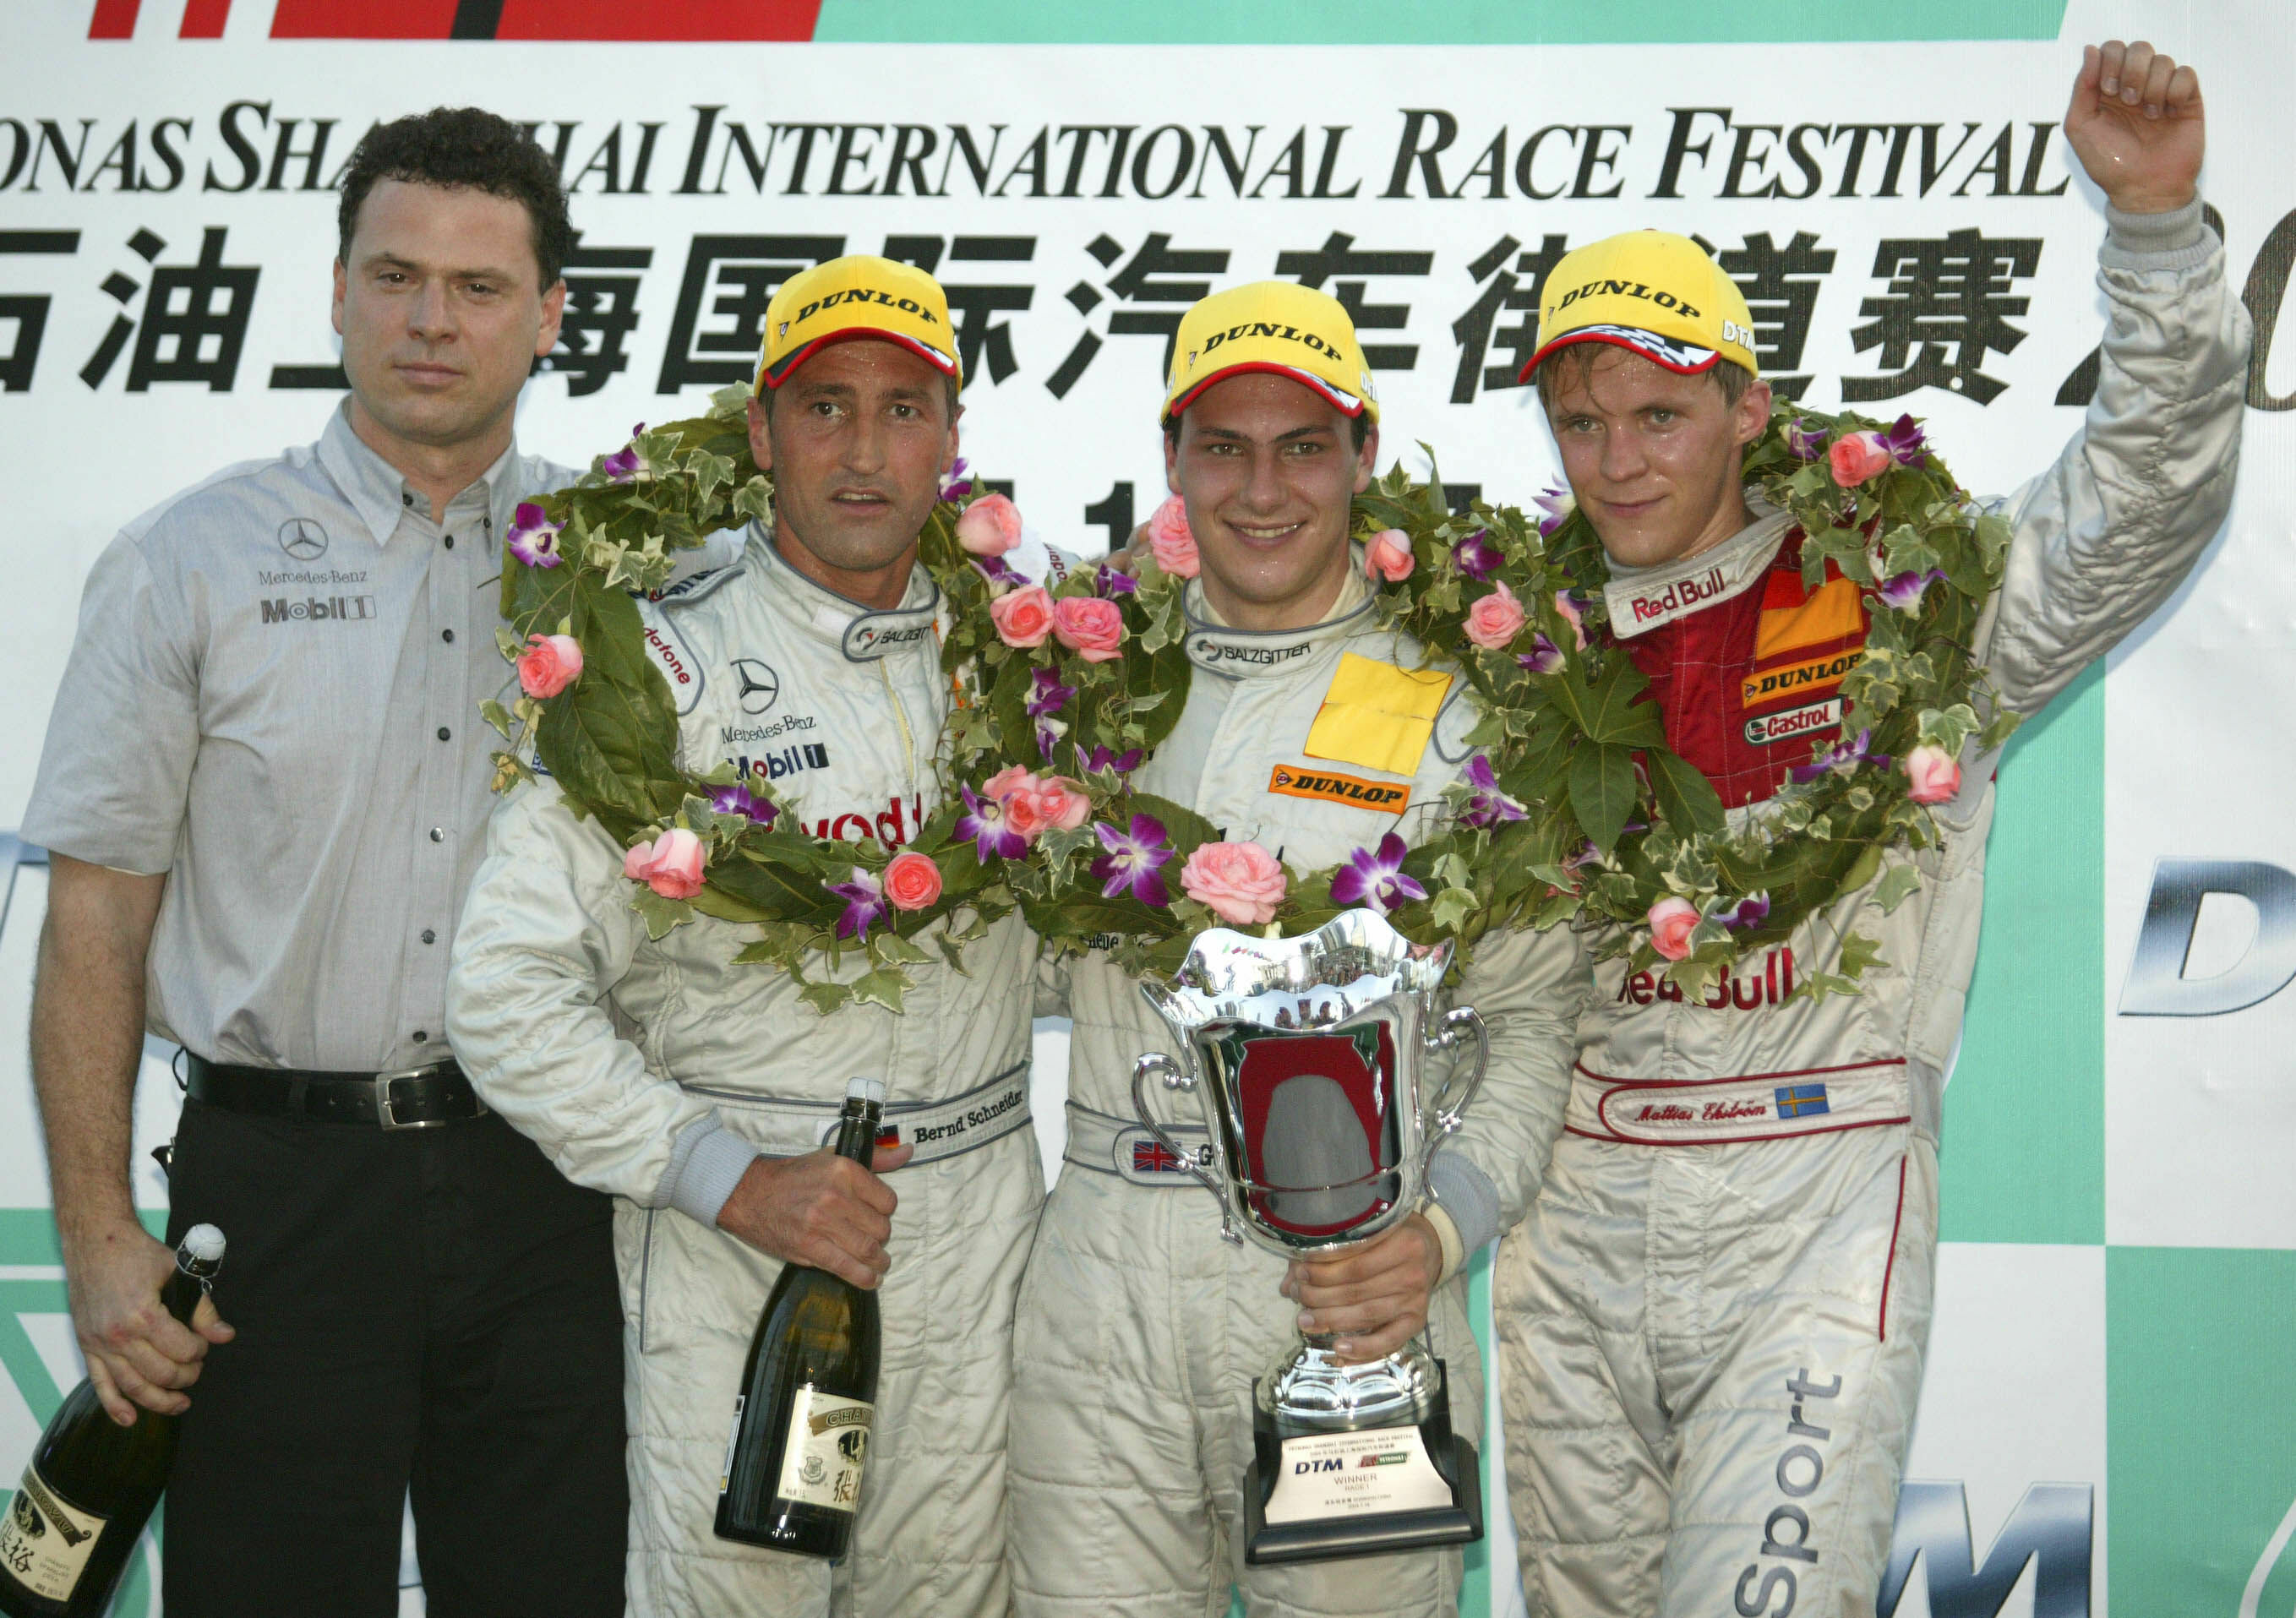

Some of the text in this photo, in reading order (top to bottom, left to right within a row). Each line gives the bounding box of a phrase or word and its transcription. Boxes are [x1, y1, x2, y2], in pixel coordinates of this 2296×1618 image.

[672, 105, 1361, 199] INTERNATIONAL
[1377, 108, 1633, 200] RACE
[1645, 106, 2070, 199] FESTIVAL
[795, 288, 938, 324] DUNLOP
[1559, 280, 1701, 319] DUNLOP
[1203, 323, 1343, 362] DUNLOP
[259, 569, 368, 586] Mercedes-Benz
[1631, 567, 1725, 623] Red Bull
[260, 597, 347, 624] Mobil
[1224, 641, 1312, 665] SALZGITTER
[1759, 652, 1862, 695] DUNLOP
[722, 714, 816, 744] Mercedes-Benz
[1767, 704, 1830, 737] Castrol
[727, 745, 804, 780] Mobil
[1293, 775, 1403, 804] DUNLOP
[913, 1090, 1023, 1144] Bernd Schneider
[1295, 1457, 1344, 1475] DTM
[1333, 1473, 1377, 1485] WINNER
[1735, 1367, 1842, 1618] Sport
